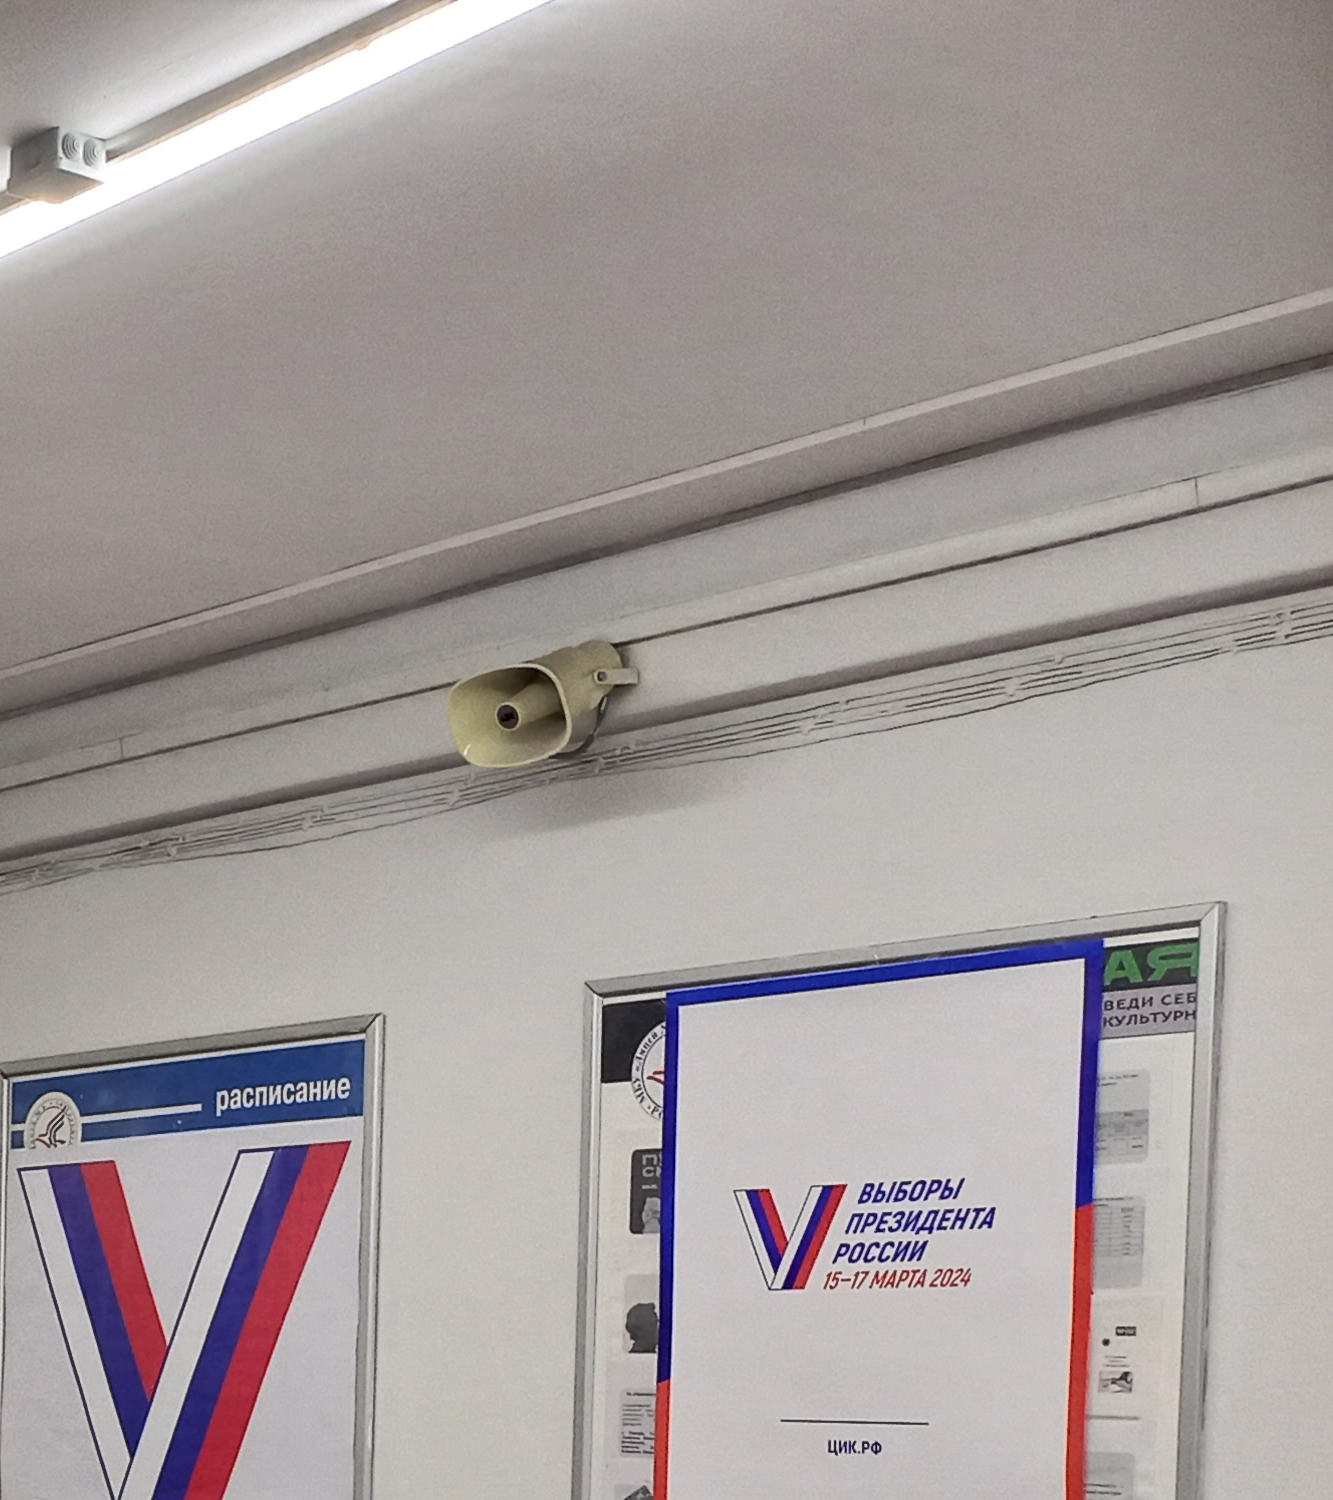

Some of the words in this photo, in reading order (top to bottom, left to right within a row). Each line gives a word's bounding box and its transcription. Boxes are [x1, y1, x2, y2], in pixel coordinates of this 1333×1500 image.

[1104, 996, 1153, 1011] ВЕДИ
[1103, 1010, 1196, 1027] КУЛЬТУРН
[214, 1077, 351, 1117] расписание
[857, 1177, 966, 1204] ВЫБОРЫ
[844, 1206, 997, 1235] ПРЕЗИДЕНТА
[831, 1240, 929, 1264] РОССИИ
[869, 1269, 927, 1290] МАРТА
[928, 1267, 972, 1288] 2024
[827, 1439, 883, 1457] ЦИК.РФ
